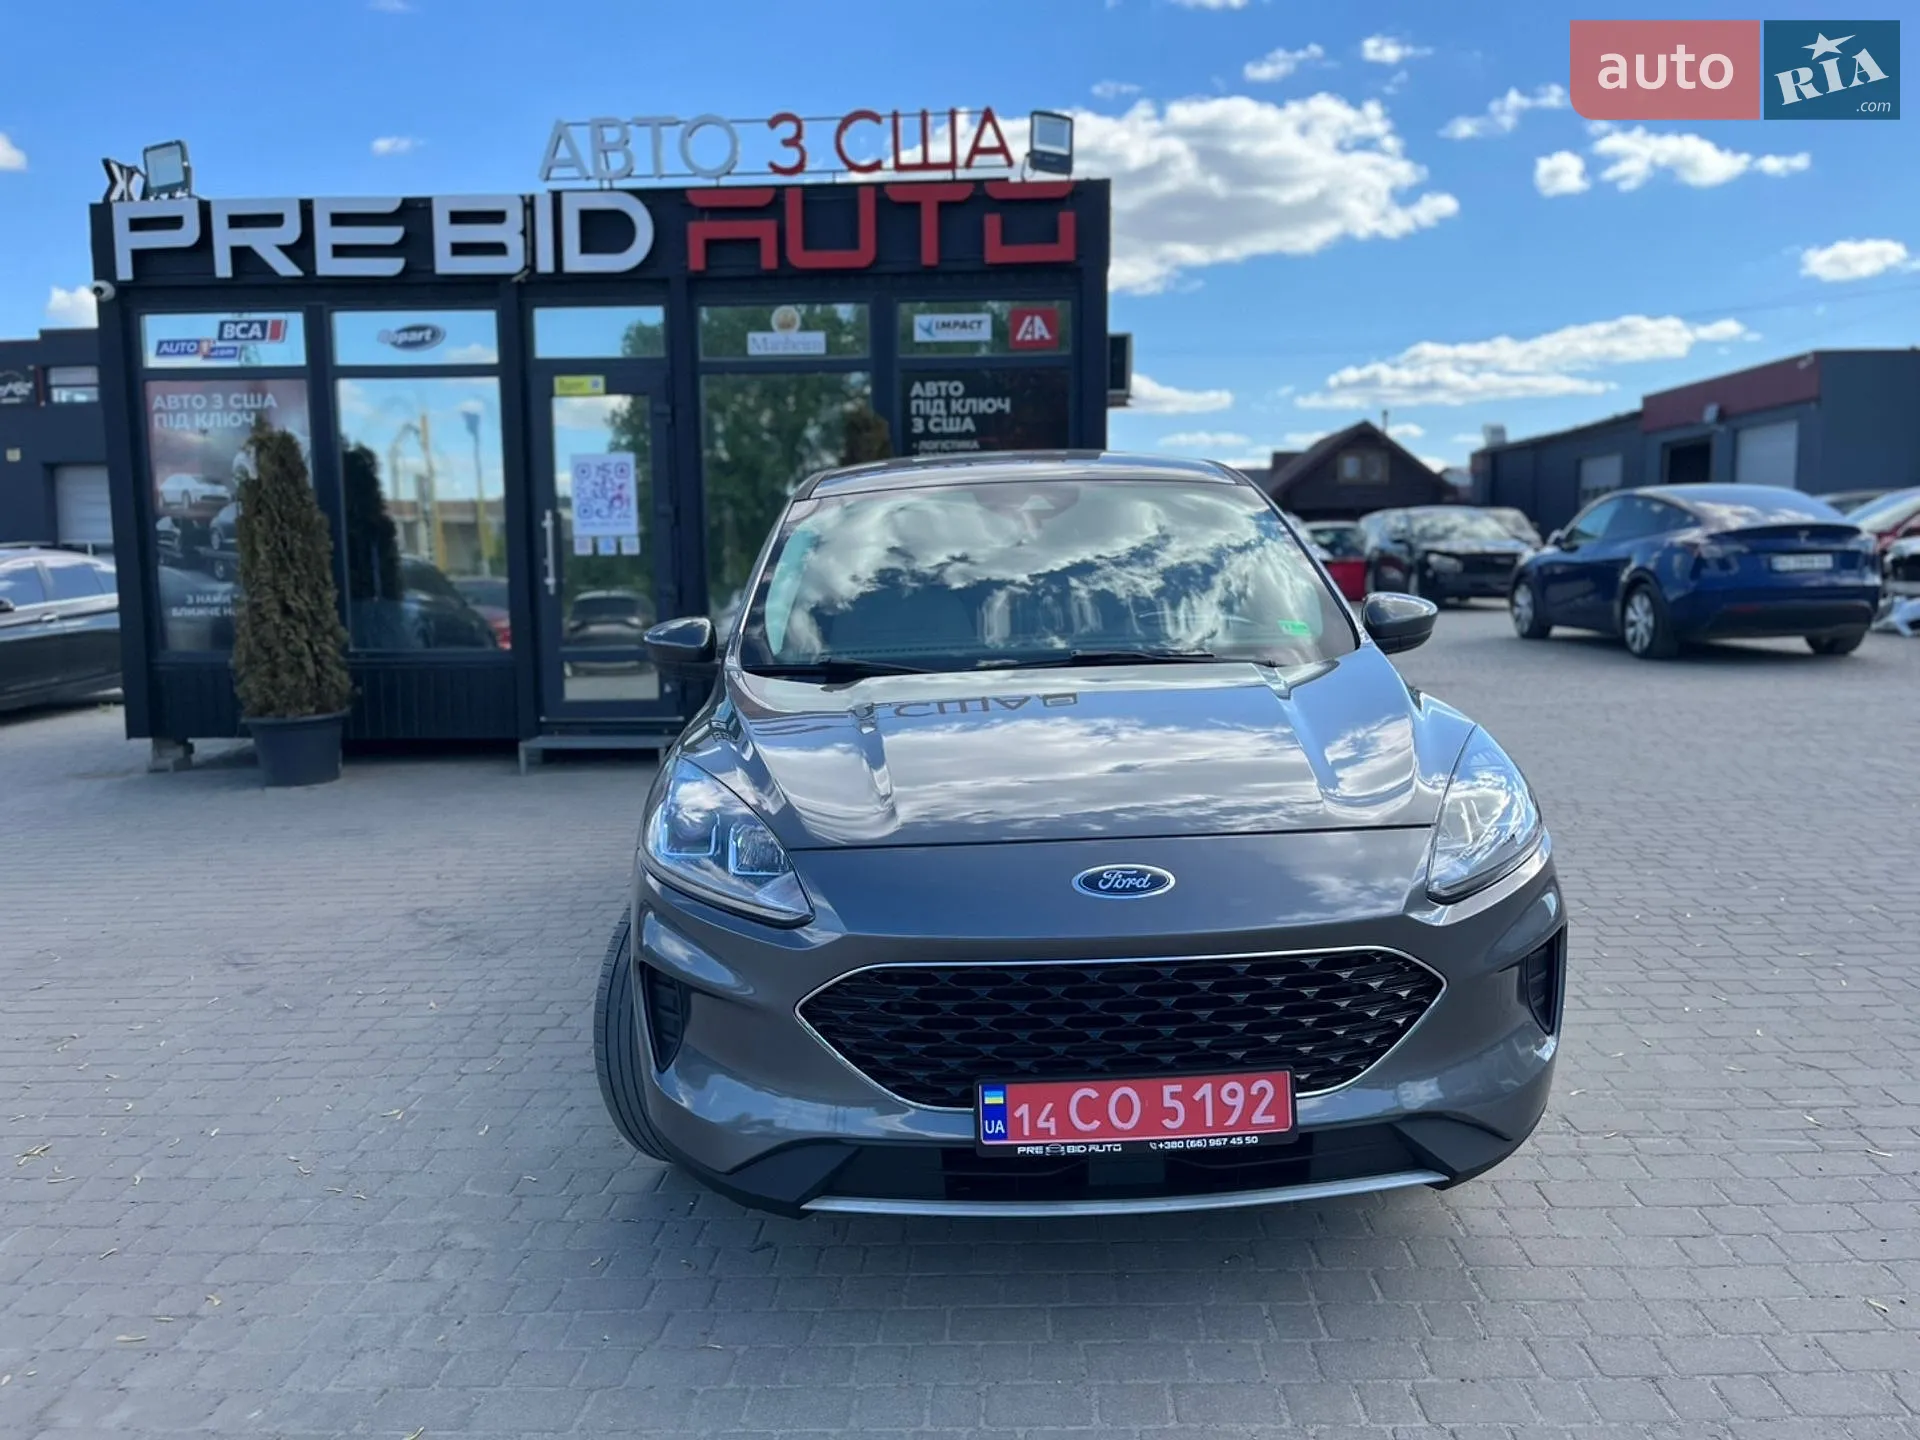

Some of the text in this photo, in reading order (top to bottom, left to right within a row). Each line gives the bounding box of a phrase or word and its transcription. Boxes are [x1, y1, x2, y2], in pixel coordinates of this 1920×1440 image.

[539, 113, 740, 181] АВТО
[835, 106, 1015, 174] США
[685, 180, 1077, 272] AUTO
[222, 322, 263, 340] BCA
[935, 319, 983, 331] IMPACT
[910, 381, 965, 398] АВТО
[152, 394, 207, 411] АВТО
[229, 393, 279, 410] США
[910, 398, 1011, 416] ПІД КЛЮЧ
[153, 411, 257, 430] ПІД КЛЮЧ
[928, 416, 976, 433] США
[1097, 869, 1153, 890] Ford
[1013, 1103, 1057, 1136] 14
[1161, 1079, 1276, 1130] 5192
[984, 1119, 1005, 1135] UA
